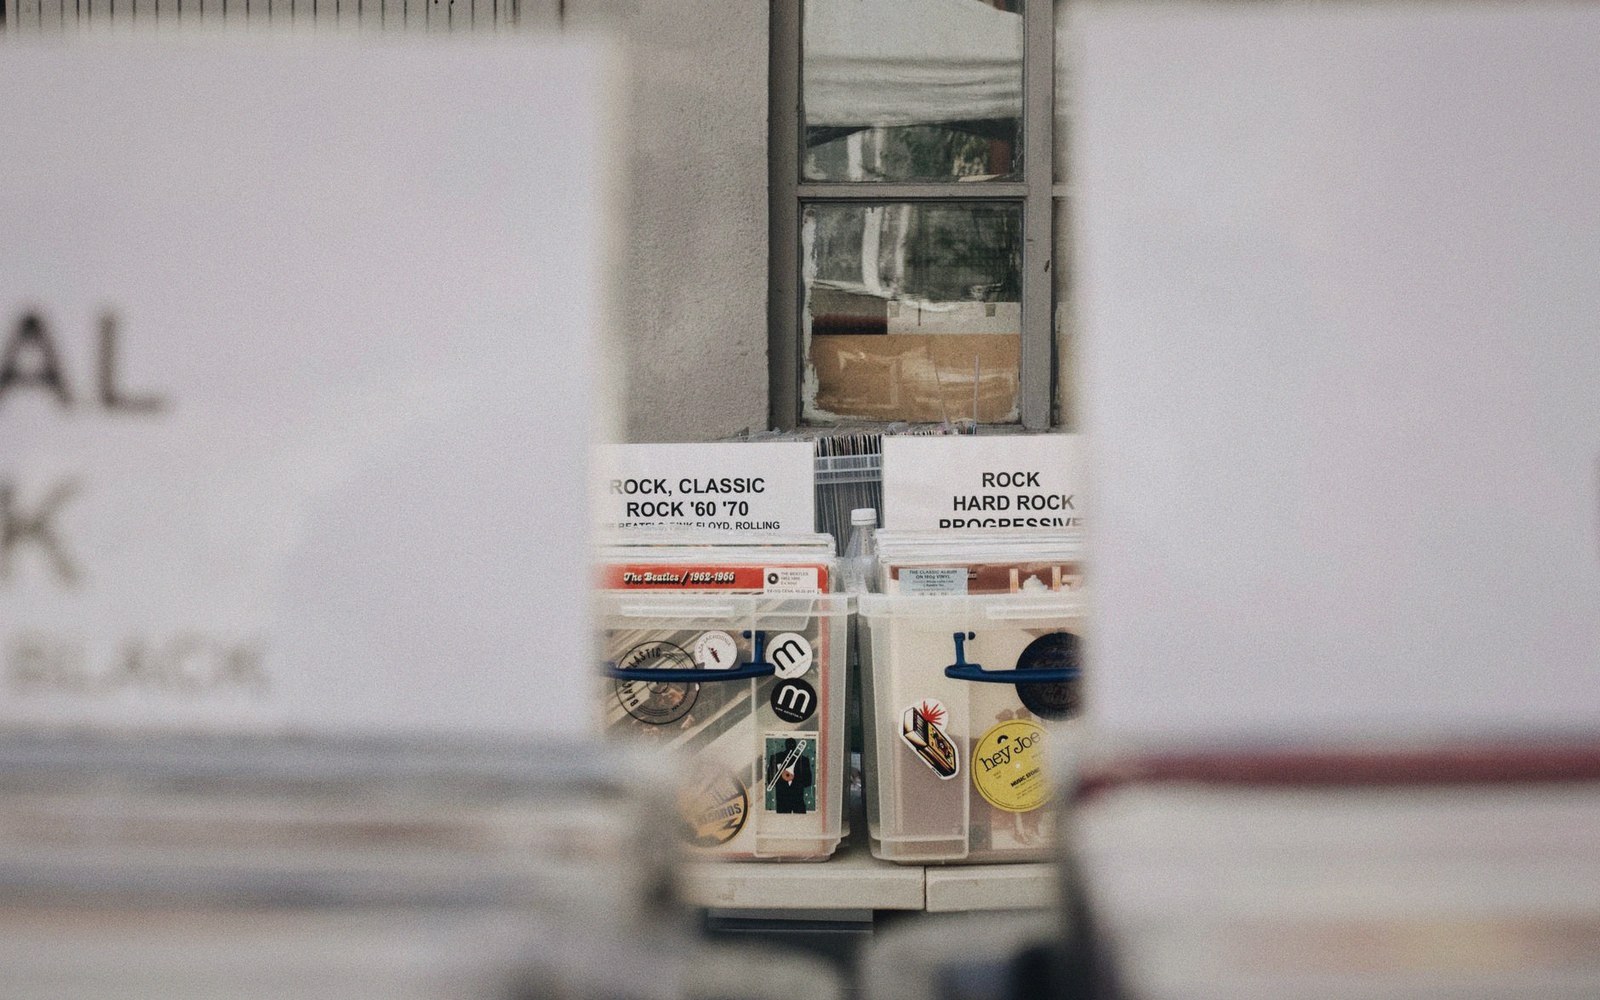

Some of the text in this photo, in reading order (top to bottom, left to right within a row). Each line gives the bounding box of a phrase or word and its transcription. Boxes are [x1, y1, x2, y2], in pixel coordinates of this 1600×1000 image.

[610, 477, 765, 496] ROCK, CLASSIC
[982, 471, 1041, 488] ROCK
[627, 501, 749, 518] ROCK '60 '70
[953, 494, 1075, 511] HARD ROCK
[735, 521, 780, 530] ROLLING
[623, 572, 643, 584] The
[644, 572, 680, 584] Beatles
[690, 571, 736, 584] 1962-1966
[979, 731, 1042, 772] hey Joe
[1010, 775, 1027, 787] MUSIC
